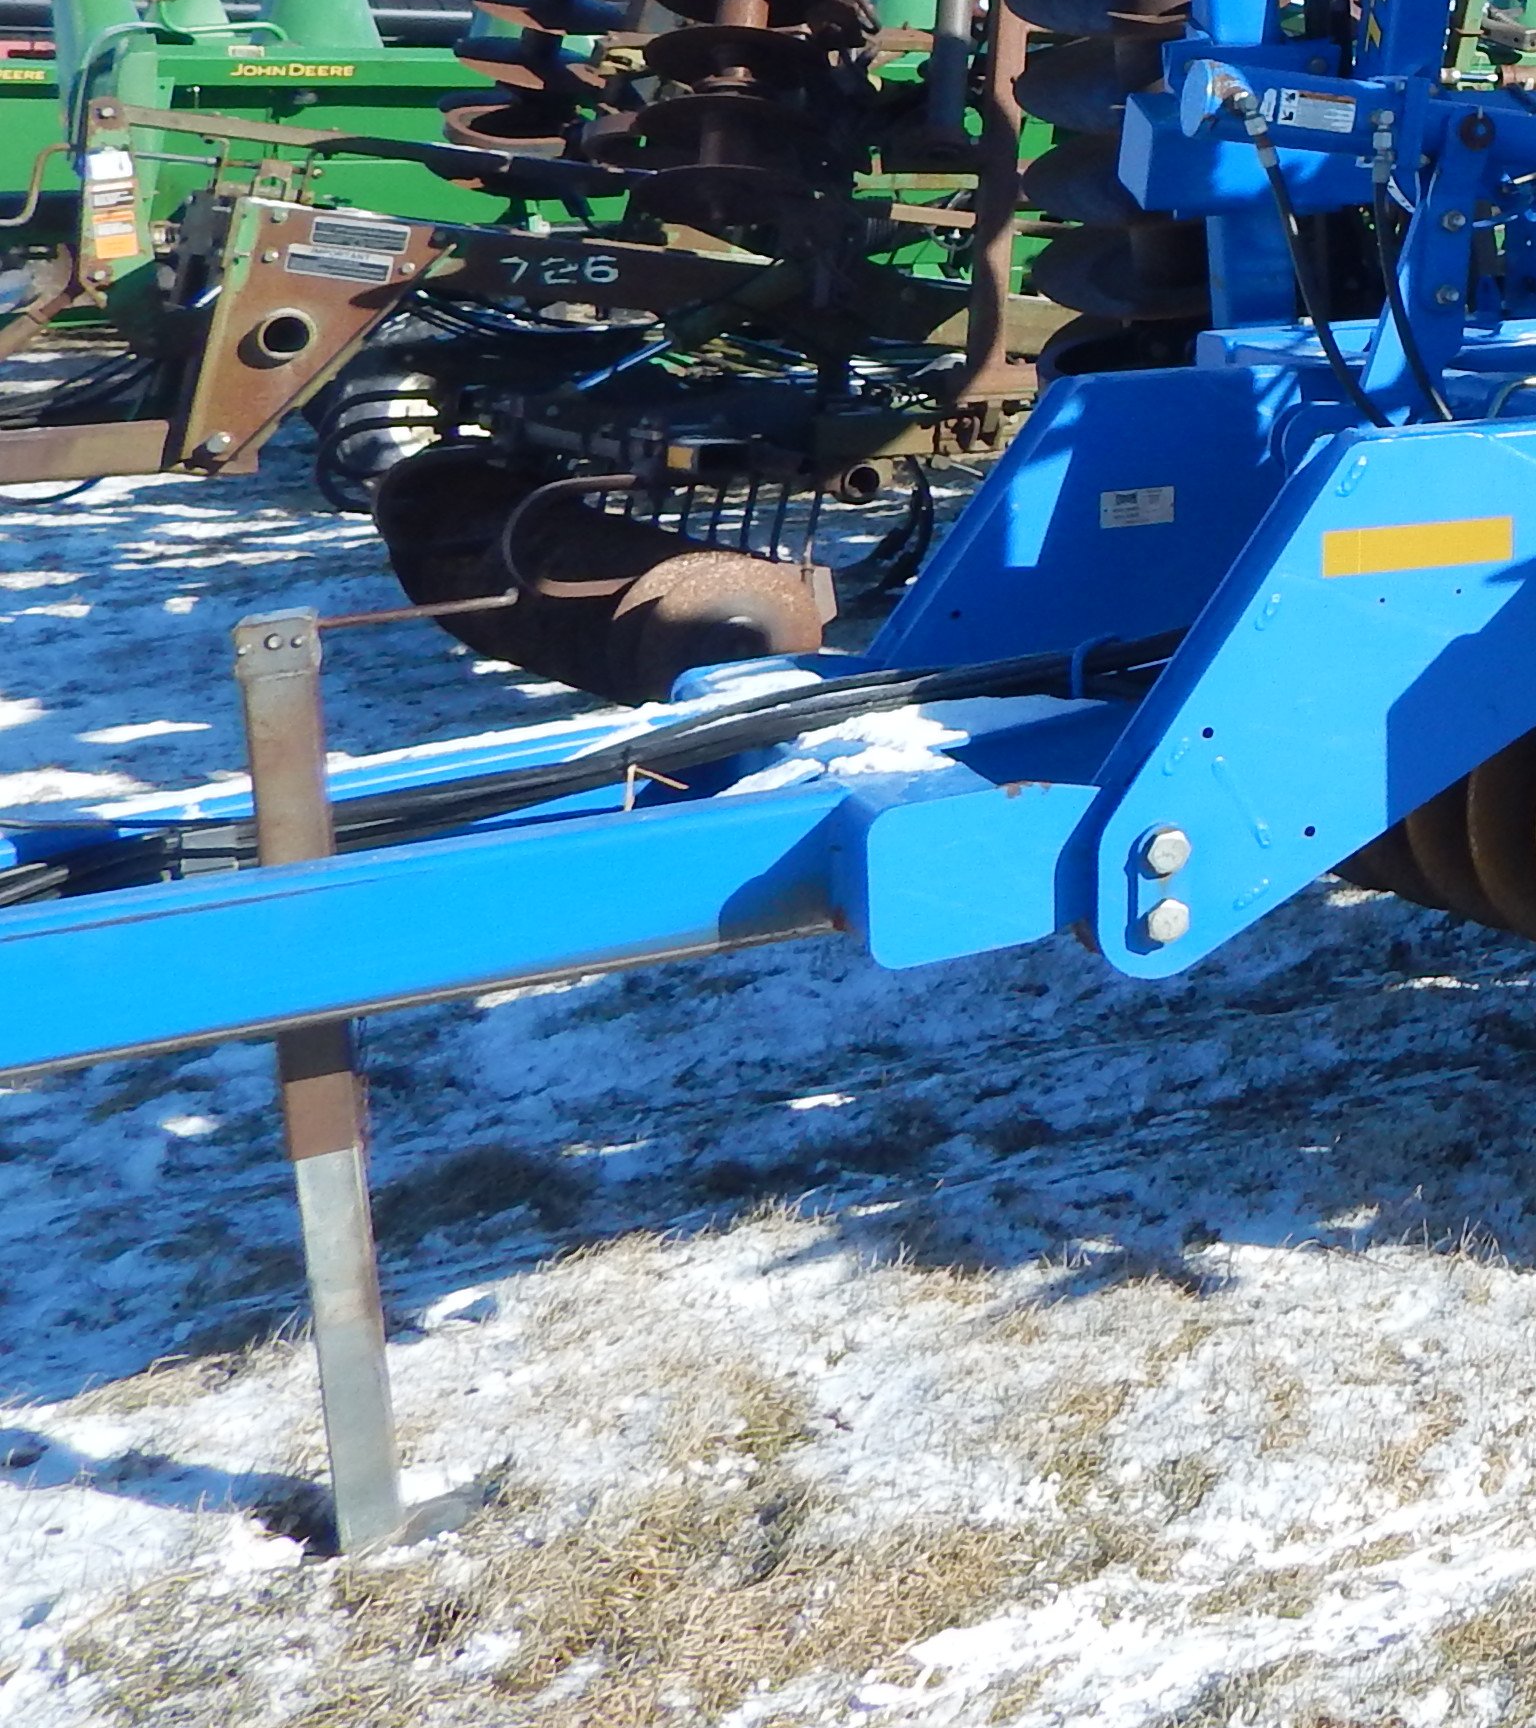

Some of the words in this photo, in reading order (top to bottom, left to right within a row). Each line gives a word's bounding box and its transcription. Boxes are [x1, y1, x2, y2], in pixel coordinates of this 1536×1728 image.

[0, 69, 46, 80] EERE
[230, 63, 286, 77] JOHN
[288, 63, 355, 77] DEERE
[499, 255, 619, 285] 726
